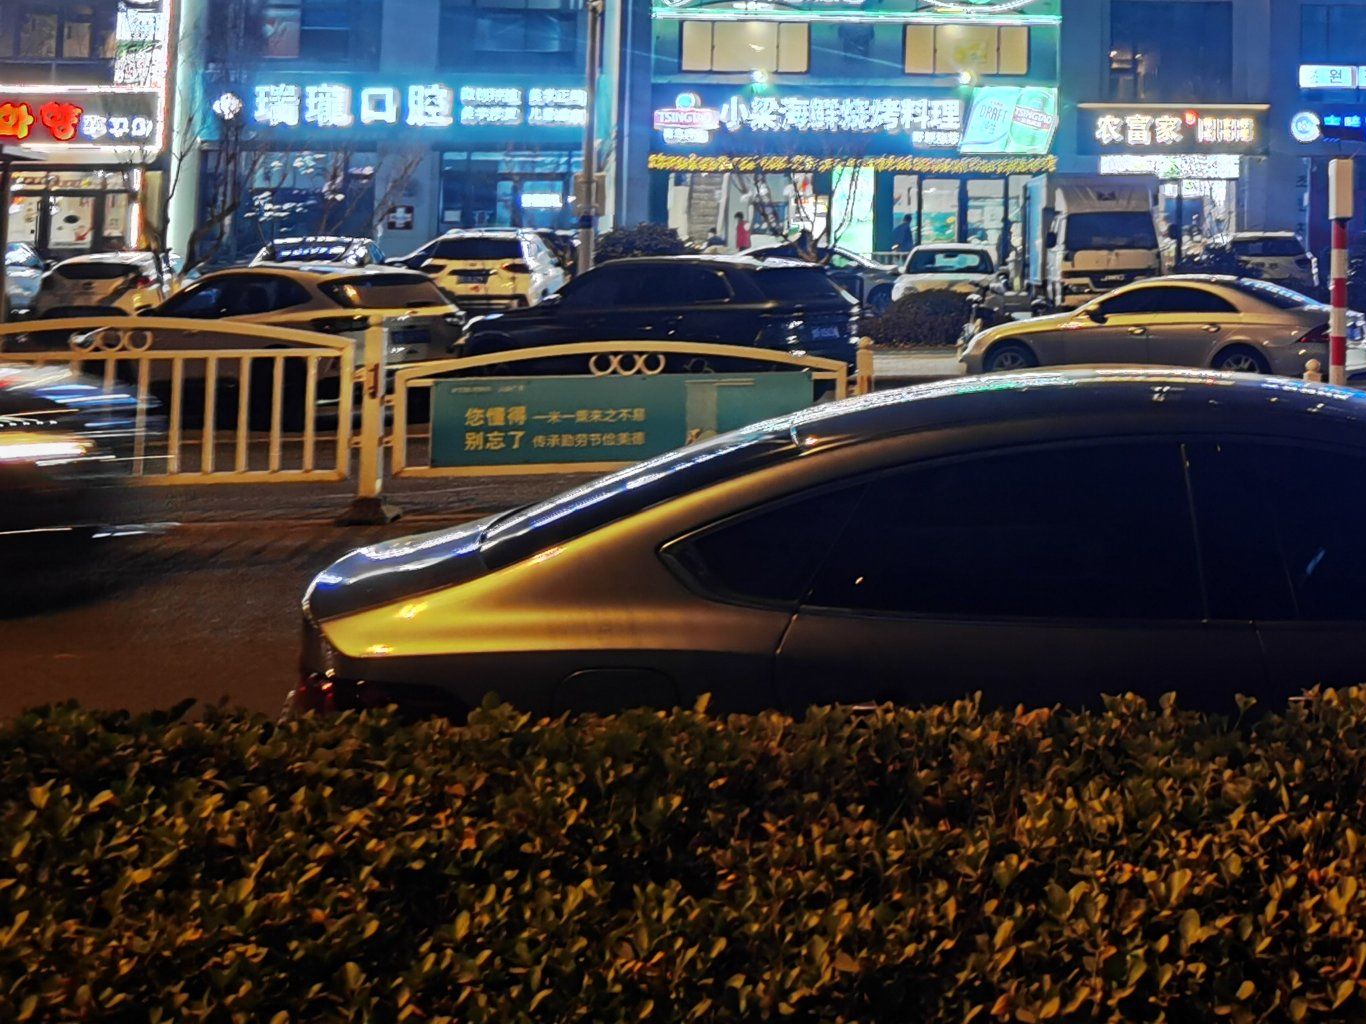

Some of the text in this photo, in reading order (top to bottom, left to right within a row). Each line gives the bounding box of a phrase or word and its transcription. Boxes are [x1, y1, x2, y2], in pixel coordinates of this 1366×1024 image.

[719, 95, 961, 134] 小梁海鲜烧烤料理
[1095, 114, 1184, 145] 农富家
[464, 406, 527, 427] 您懂得
[464, 431, 527, 451] 别忘了
